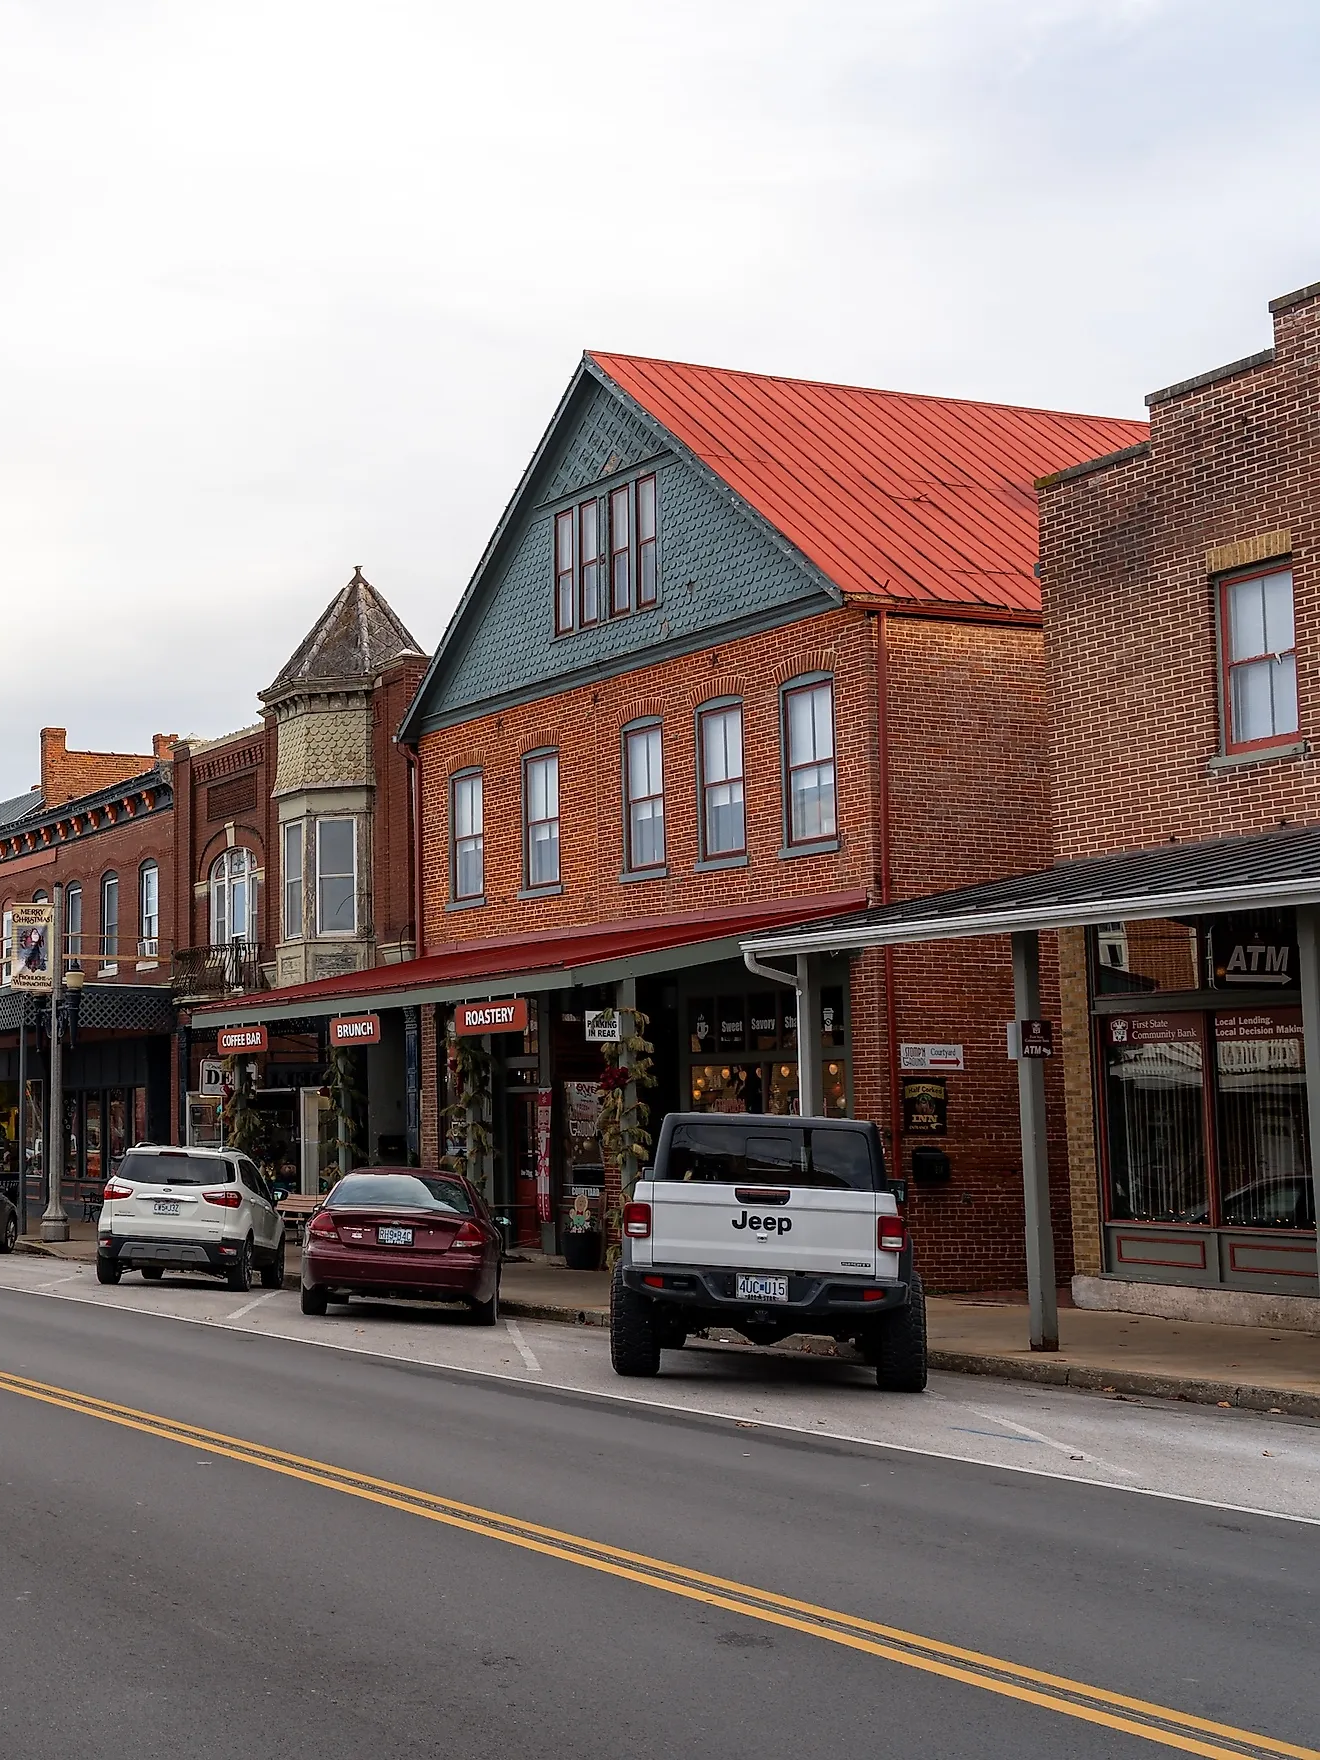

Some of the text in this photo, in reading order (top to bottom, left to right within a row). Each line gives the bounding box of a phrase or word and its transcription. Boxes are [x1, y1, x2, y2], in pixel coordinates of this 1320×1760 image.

[12, 912, 54, 924] CHRISTMAS!
[20, 908, 46, 916] MERRY
[1227, 945, 1290, 972] ATM
[464, 1006, 516, 1026] ROASTERY
[1215, 1016, 1274, 1028] Local Lending.
[336, 1021, 374, 1039] BRUNCH
[721, 1020, 743, 1033] Sweet
[750, 1017, 776, 1031] Savory
[1132, 1019, 1169, 1030] First State
[588, 1029, 617, 1038] IN REAR
[1132, 1030, 1175, 1042] Community
[1177, 1028, 1197, 1038] Bank
[1216, 1027, 1237, 1037] Local
[1239, 1026, 1274, 1036] Decision
[221, 1031, 262, 1048] COFFEE BAR
[930, 1047, 957, 1058] Courtyard
[1023, 1045, 1042, 1055] ATM
[911, 1114, 938, 1123] INN
[731, 1210, 793, 1236] Jeep
